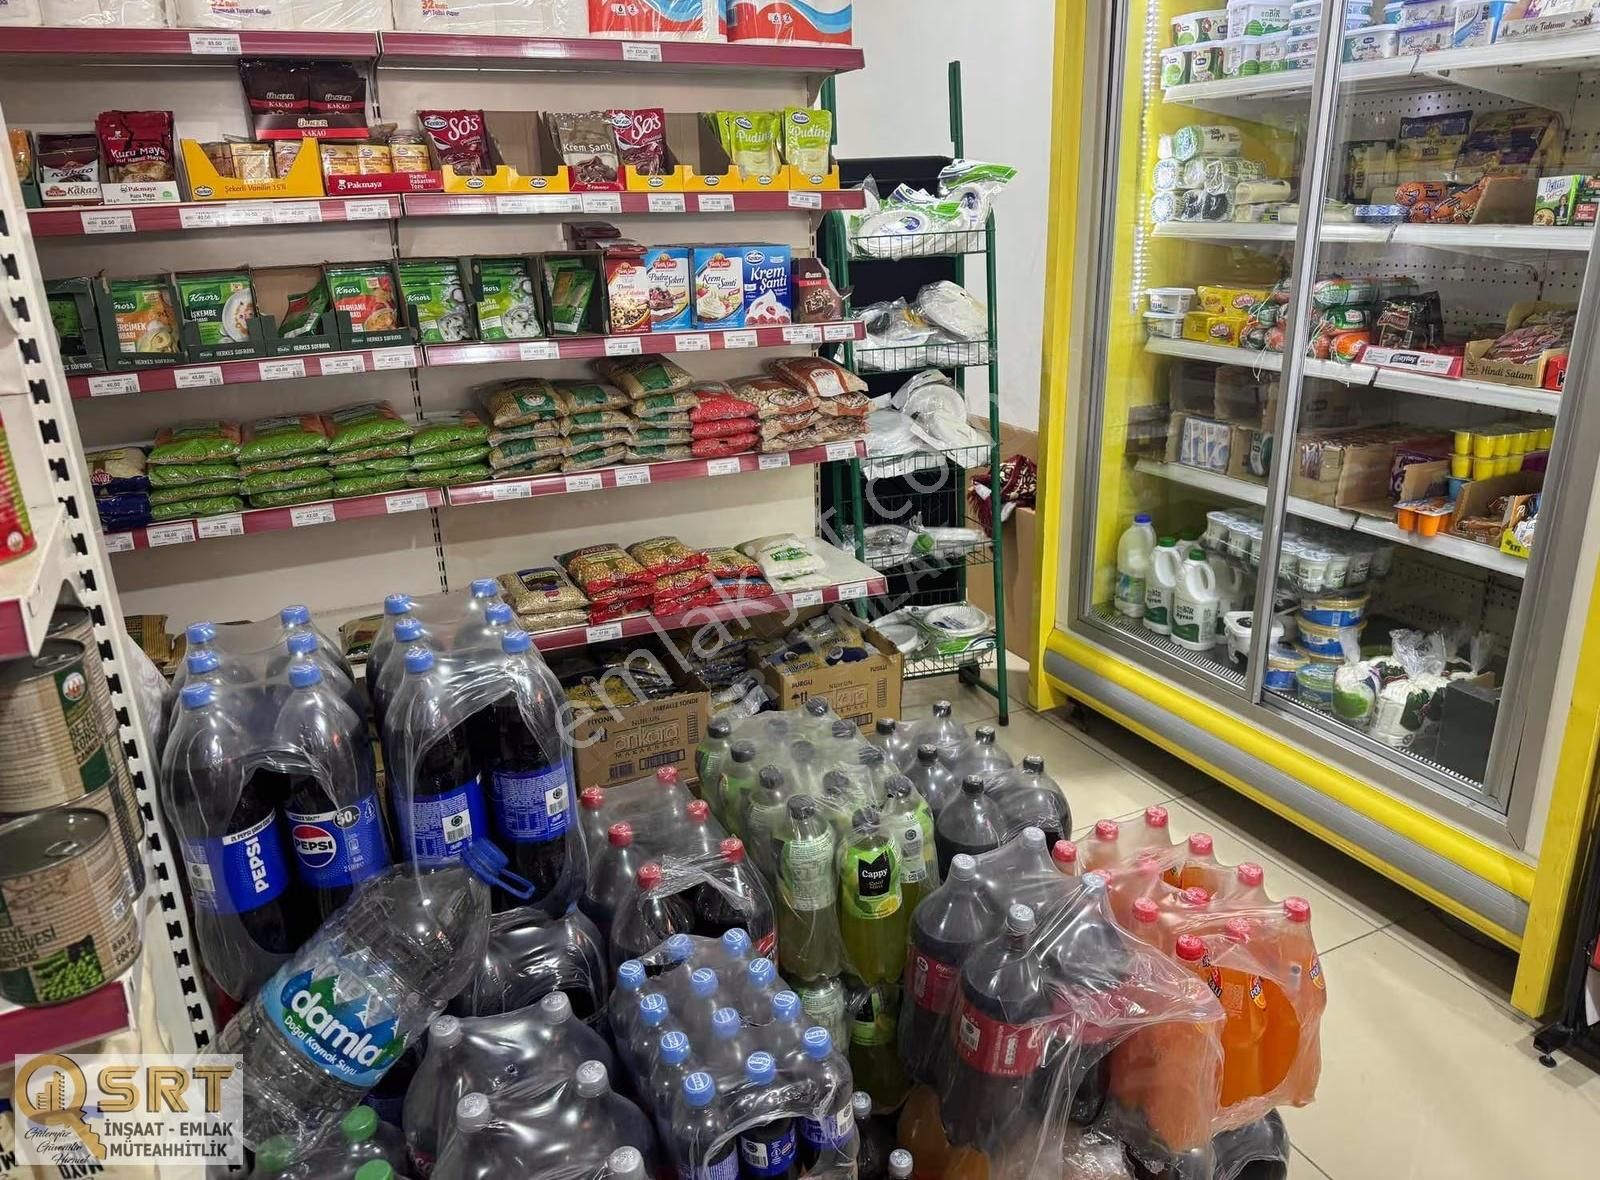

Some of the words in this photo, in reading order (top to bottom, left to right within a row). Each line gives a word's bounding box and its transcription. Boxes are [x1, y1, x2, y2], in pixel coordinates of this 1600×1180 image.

[298, 118, 328, 127] ÜLKER
[301, 129, 327, 137] KAKAO
[563, 142, 588, 152] Krem
[111, 148, 136, 159] Kuru
[67, 185, 98, 194] Kakao
[224, 184, 247, 193] Şekerli
[346, 180, 383, 190] Pakmaya
[702, 274, 721, 283] Krem
[751, 266, 785, 281] Krem
[760, 276, 786, 293] Şanti
[335, 286, 361, 294] Knorr
[189, 294, 220, 302] Knorr
[407, 293, 431, 302] Knorr
[1481, 366, 1504, 377] Hindi
[1504, 367, 1534, 381] Salam
[615, 721, 681, 750] ankara
[294, 839, 333, 851] PEPSI
[244, 835, 270, 894] PEPSI
[861, 868, 888, 880] Cappy
[291, 989, 384, 1067] damla
[284, 1015, 308, 1041] Doğal
[306, 1036, 337, 1065] Kaynak
[335, 1059, 358, 1076] Suyu
